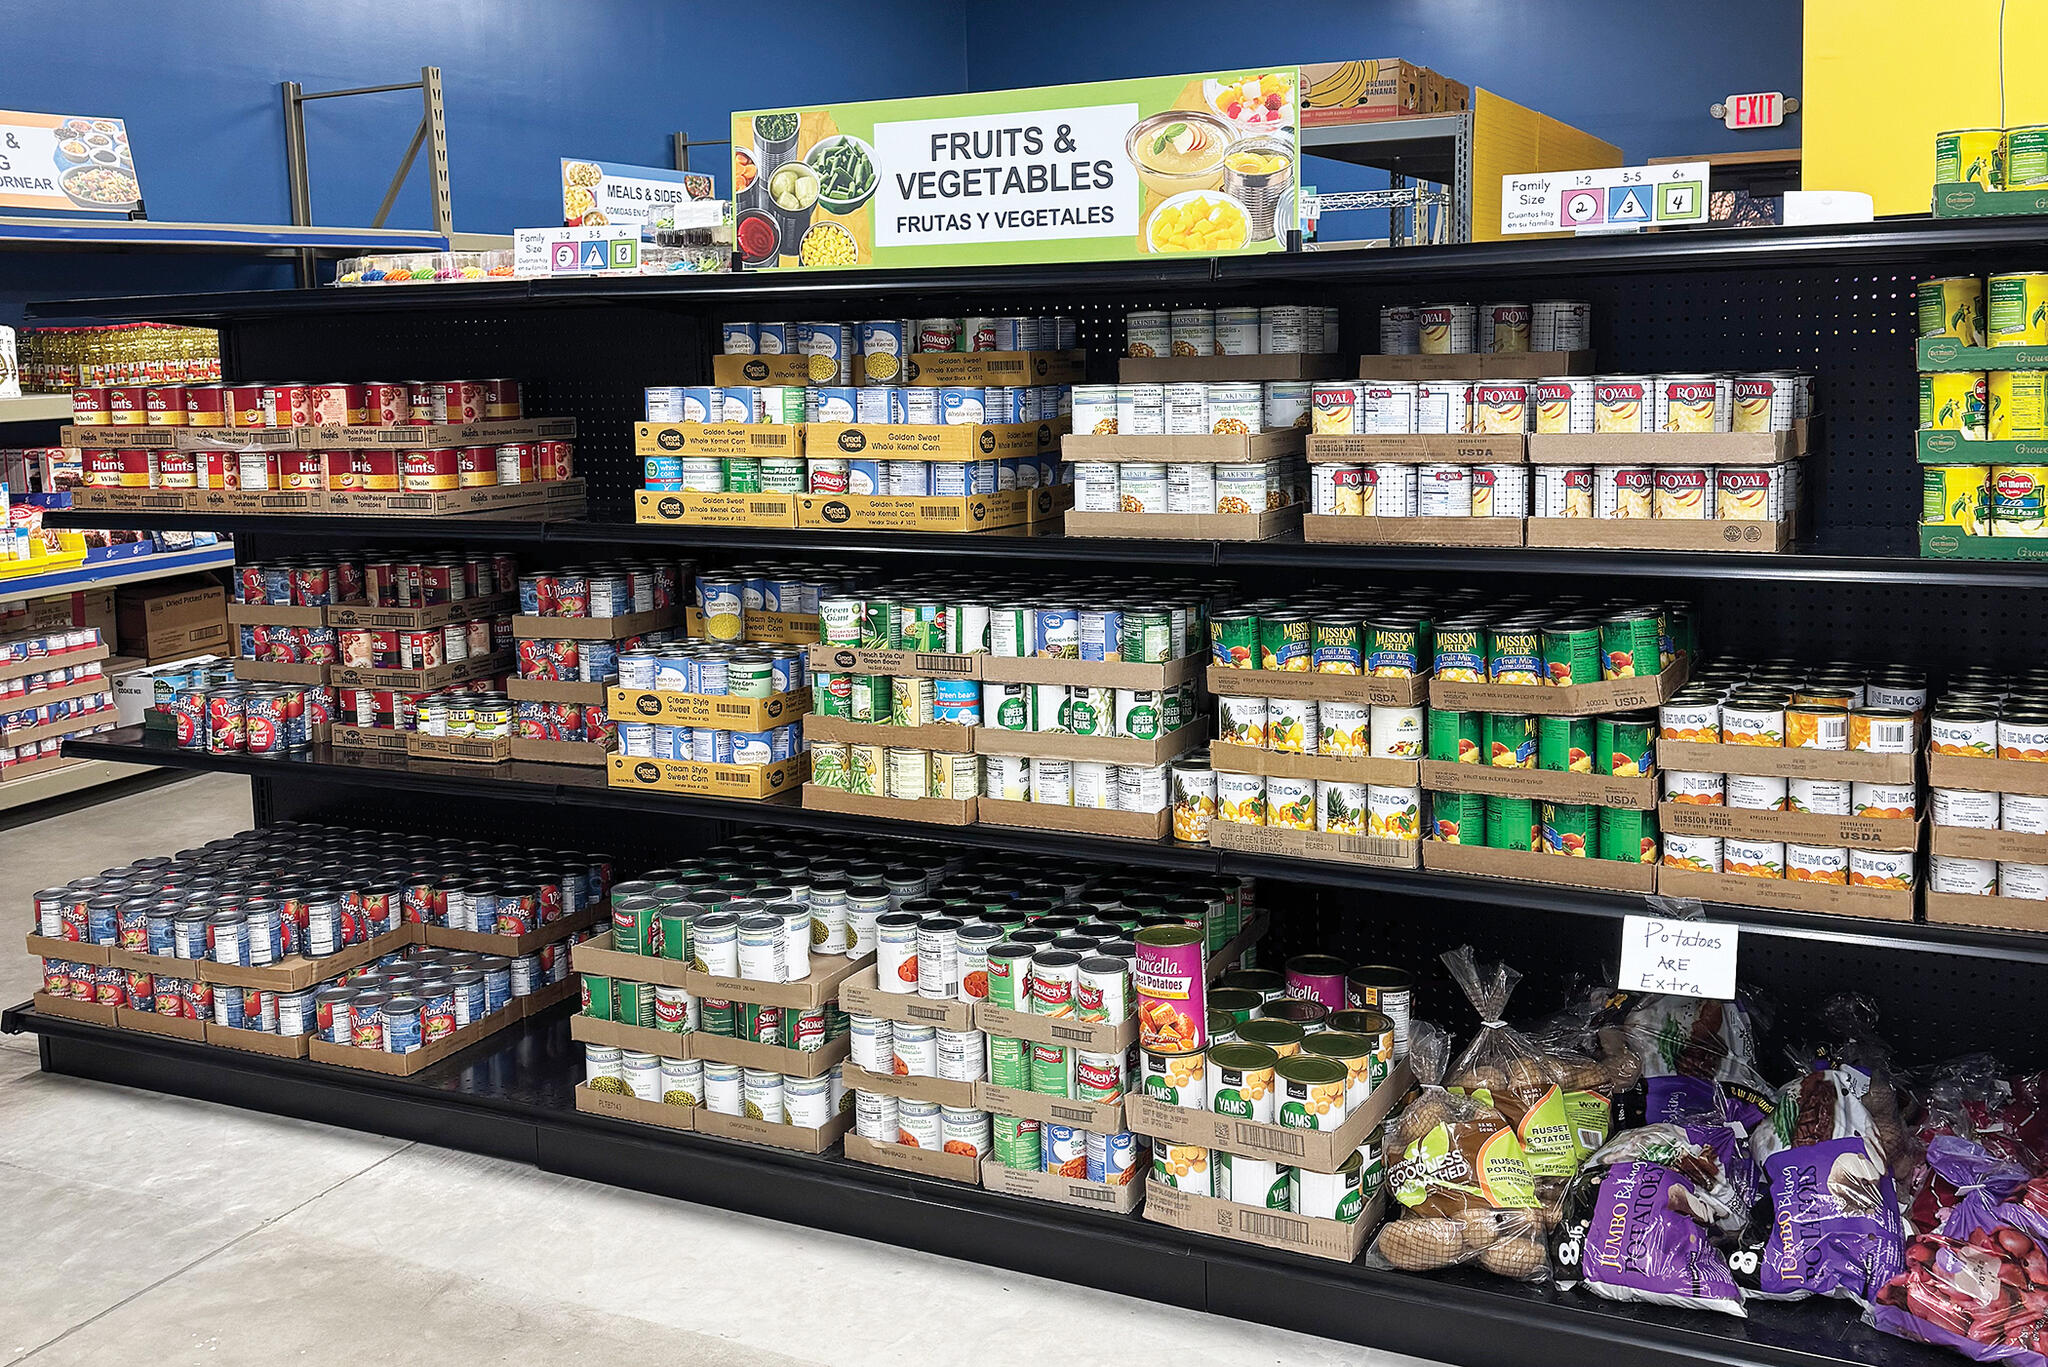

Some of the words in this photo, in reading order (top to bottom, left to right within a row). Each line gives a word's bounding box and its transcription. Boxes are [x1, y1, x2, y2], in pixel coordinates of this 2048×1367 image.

[1366, 79, 1397, 88] PREMIUM
[1736, 95, 1775, 126] EXIT
[6, 132, 20, 148] &
[931, 126, 1044, 162] FRUITS
[1054, 124, 1078, 154] &
[896, 160, 1114, 200] VEGETABLES
[1576, 176, 1592, 186] 1-2
[1672, 169, 1685, 179] 6+
[1512, 179, 1551, 196] Family
[607, 184, 642, 200] MEALS
[645, 191, 651, 200] &
[654, 190, 682, 204] SIDES
[1520, 194, 1546, 206] Size
[1576, 201, 1588, 213] 2
[1623, 201, 1634, 213] 3
[1674, 195, 1682, 210] 4
[605, 206, 632, 217] COMIDAS
[1508, 211, 1540, 220] Cuantos
[1542, 210, 1555, 220] hay
[896, 212, 972, 234] FRUTAS
[977, 211, 990, 230] Y
[994, 206, 1114, 230] VEGETALES
[520, 233, 546, 244] Family
[560, 232, 570, 240] 1-2
[526, 244, 542, 254] Size
[560, 250, 568, 262] 5
[620, 247, 628, 261] 8
[1420, 312, 1446, 324] OYAL
[922, 332, 954, 346] Stokely's
[1314, 390, 1349, 407] ROYAL
[1483, 390, 1522, 404] ROYAL
[1538, 388, 1564, 402] OYAL
[1598, 388, 1636, 400] ROYAL
[1676, 387, 1714, 400] ROYAL
[660, 434, 680, 442] Great
[710, 437, 730, 445] Kernel
[841, 434, 861, 444] Great
[888, 433, 916, 442] Golden
[917, 433, 940, 441] Sweet
[872, 443, 894, 451] Whole
[896, 443, 922, 451] Kernel
[923, 443, 940, 451] Corn
[1458, 448, 1494, 456] USDA
[161, 460, 194, 472] Hunt's
[813, 473, 848, 486] Stokely's
[1660, 474, 1700, 488] ROYAL
[1722, 475, 1764, 489] ROYAL
[1999, 481, 2007, 489] Del
[2008, 481, 2032, 489] Monte
[870, 501, 891, 510] Golden
[892, 501, 914, 510] Sweet
[1996, 508, 2014, 516] Sliced
[2018, 508, 2039, 516] Pears
[824, 606, 850, 614] Green
[766, 616, 783, 624] Style
[826, 614, 850, 622] Giant
[1317, 626, 1356, 643] MISSION
[1376, 631, 1415, 648] MISSION
[1436, 632, 1477, 648] MISSION
[1324, 638, 1350, 646] PRIDE
[1382, 643, 1409, 651] PRIDE
[1496, 635, 1538, 651] MISSION
[1322, 647, 1337, 655] Fruit
[1338, 647, 1351, 655] Mix
[1443, 644, 1469, 653] PRIDE
[1504, 646, 1531, 656] PRIDE
[1441, 654, 1457, 662] Fruit
[1501, 657, 1516, 665] Fruit
[639, 699, 658, 707] Great
[693, 697, 709, 706] Style
[1370, 694, 1398, 703] USDA
[1614, 696, 1648, 707] USDA
[1872, 692, 1922, 706] NEMCO
[668, 705, 689, 713] Sweet
[693, 706, 709, 714] Corn
[1003, 708, 1023, 717] GREEN
[1003, 716, 1024, 725] BEANS
[1132, 715, 1153, 724] GREEN
[1132, 723, 1154, 734] BEANS
[665, 764, 689, 772] Cream
[691, 766, 708, 774] Style
[667, 773, 688, 781] Sweet
[1606, 794, 1638, 806] USDA
[1674, 814, 1706, 824] MISSION
[1708, 818, 1732, 826] PRIDE
[1235, 834, 1258, 844] GREEN
[1260, 837, 1283, 847] BEANS
[1840, 832, 1882, 842] USDA
[1644, 922, 1722, 950] Potatoes
[1658, 956, 1691, 972] ARE
[1033, 980, 1068, 998] Stokely's
[1148, 976, 1182, 990] Potatoes
[1640, 973, 1702, 994] Extra
[1078, 1064, 1117, 1087] Stokely's
[1146, 1084, 1172, 1100] YAMS
[1218, 1097, 1246, 1114] YAMS
[1284, 1110, 1311, 1128] YAMS
[1532, 1125, 1568, 1135] RUSSET
[1389, 1150, 1462, 1186] GOODNESS
[1490, 1158, 1525, 1168] RUSSET
[1342, 1201, 1362, 1216] YAMS
[1600, 1203, 1628, 1274] JUMBO
